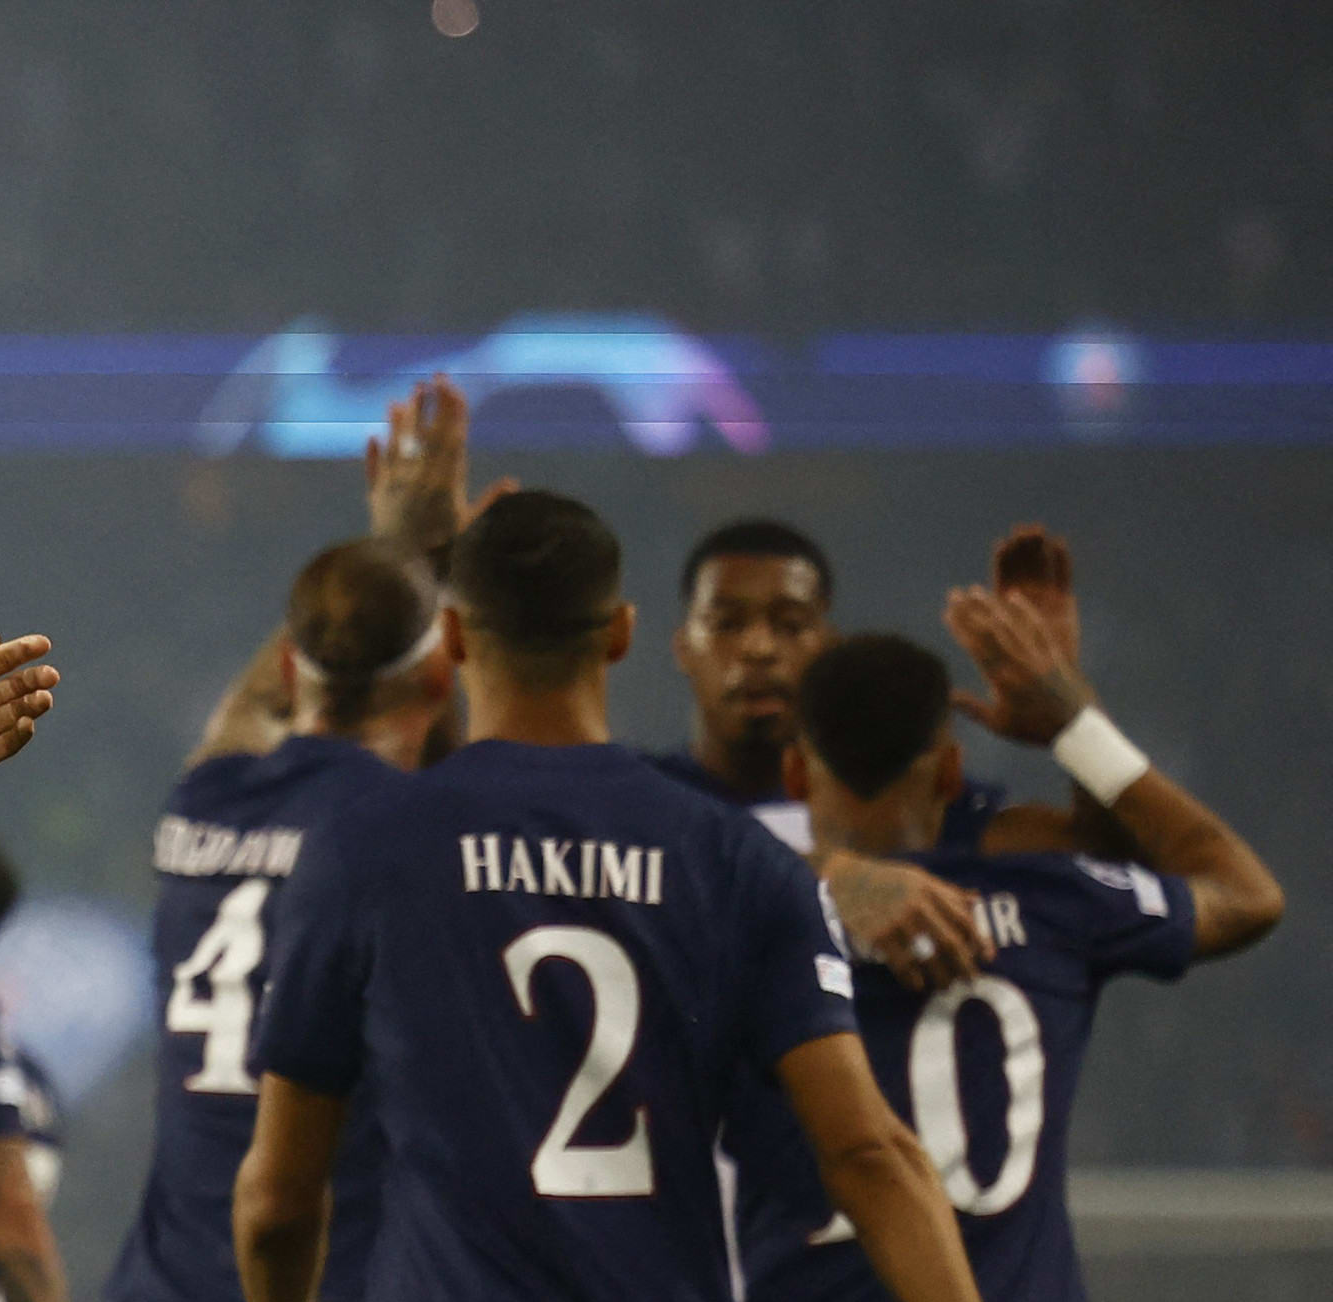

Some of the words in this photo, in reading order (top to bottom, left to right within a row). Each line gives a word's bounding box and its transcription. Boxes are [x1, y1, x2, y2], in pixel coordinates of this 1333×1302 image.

[459, 832, 665, 906] HAKIMI
[166, 877, 271, 1096] 4
[502, 924, 655, 1198] 2
